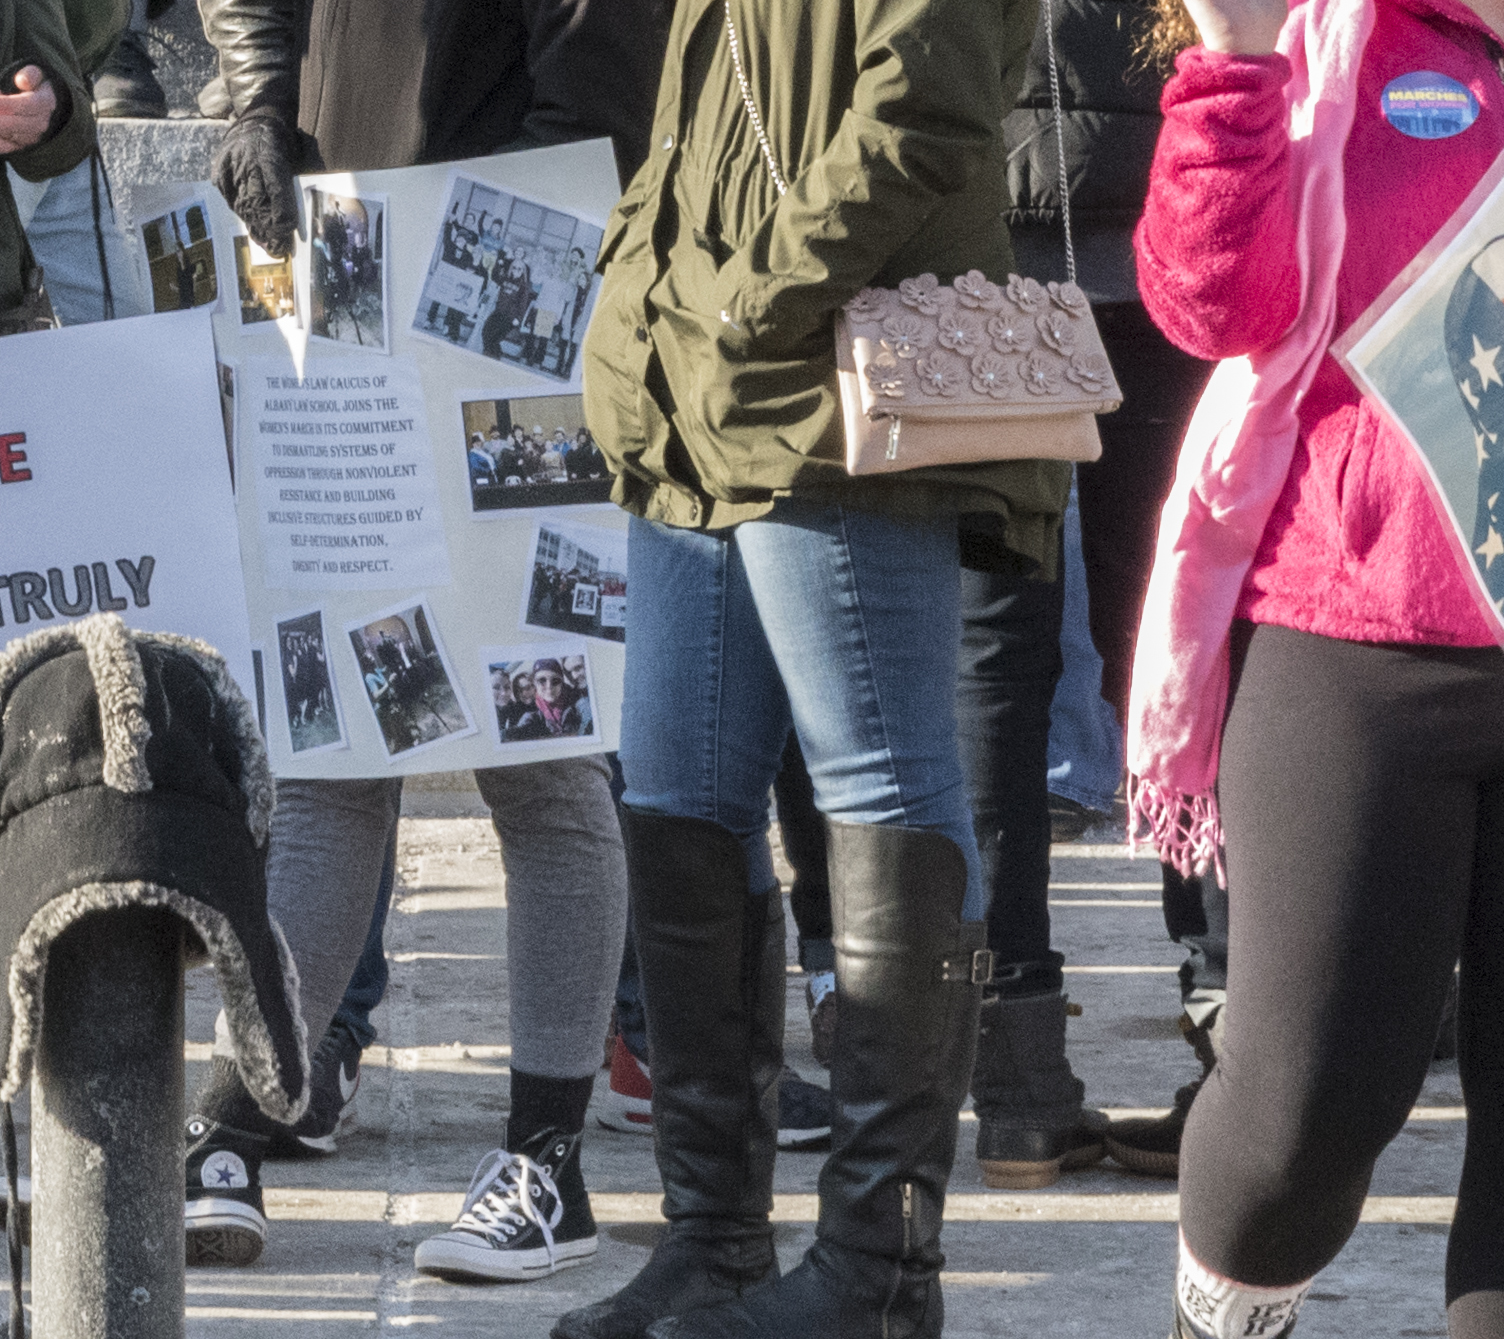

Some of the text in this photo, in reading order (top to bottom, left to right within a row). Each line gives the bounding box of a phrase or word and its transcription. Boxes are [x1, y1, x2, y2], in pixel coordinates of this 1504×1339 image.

[330, 376, 371, 390] CAUCUS
[373, 375, 388, 388] OF
[342, 399, 372, 412] JOINS
[374, 398, 399, 411] THE
[339, 419, 414, 435] COMMITMENT
[330, 444, 378, 458] SYSTEMS
[381, 443, 396, 456] OF
[344, 464, 417, 480] NONVIOLENT
[343, 488, 396, 502] BUILDING
[358, 511, 402, 524] GUIDED
[406, 507, 423, 521] BY
